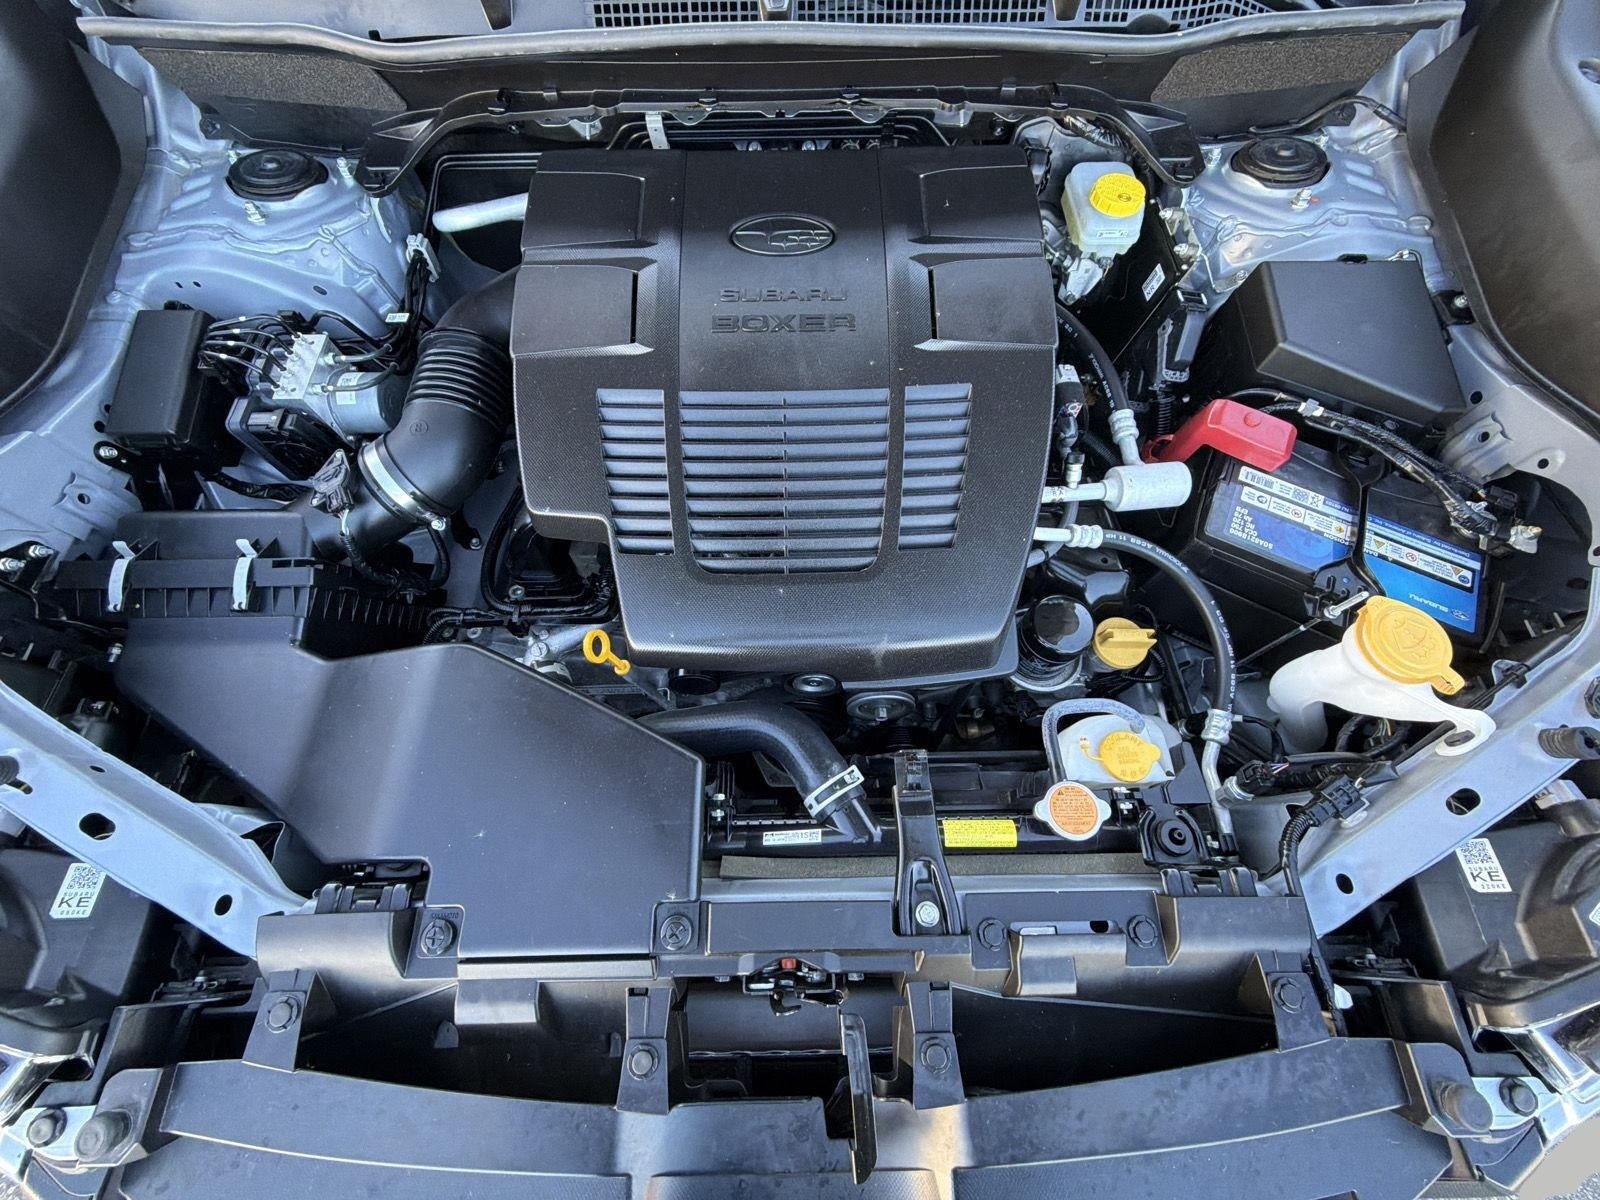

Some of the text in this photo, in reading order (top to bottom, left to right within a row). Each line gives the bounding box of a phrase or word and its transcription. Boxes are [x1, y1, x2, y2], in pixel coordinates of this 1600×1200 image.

[720, 288, 848, 303] SUBARU
[711, 313, 857, 334] BOXER
[1244, 527, 1258, 537] CCA
[1245, 522, 1256, 530] RC
[1323, 532, 1349, 546] POISON
[1363, 547, 1379, 557] DAN
[1408, 593, 1449, 613] SUBARU
[1470, 870, 1503, 882] KE
[58, 896, 91, 908] KE
